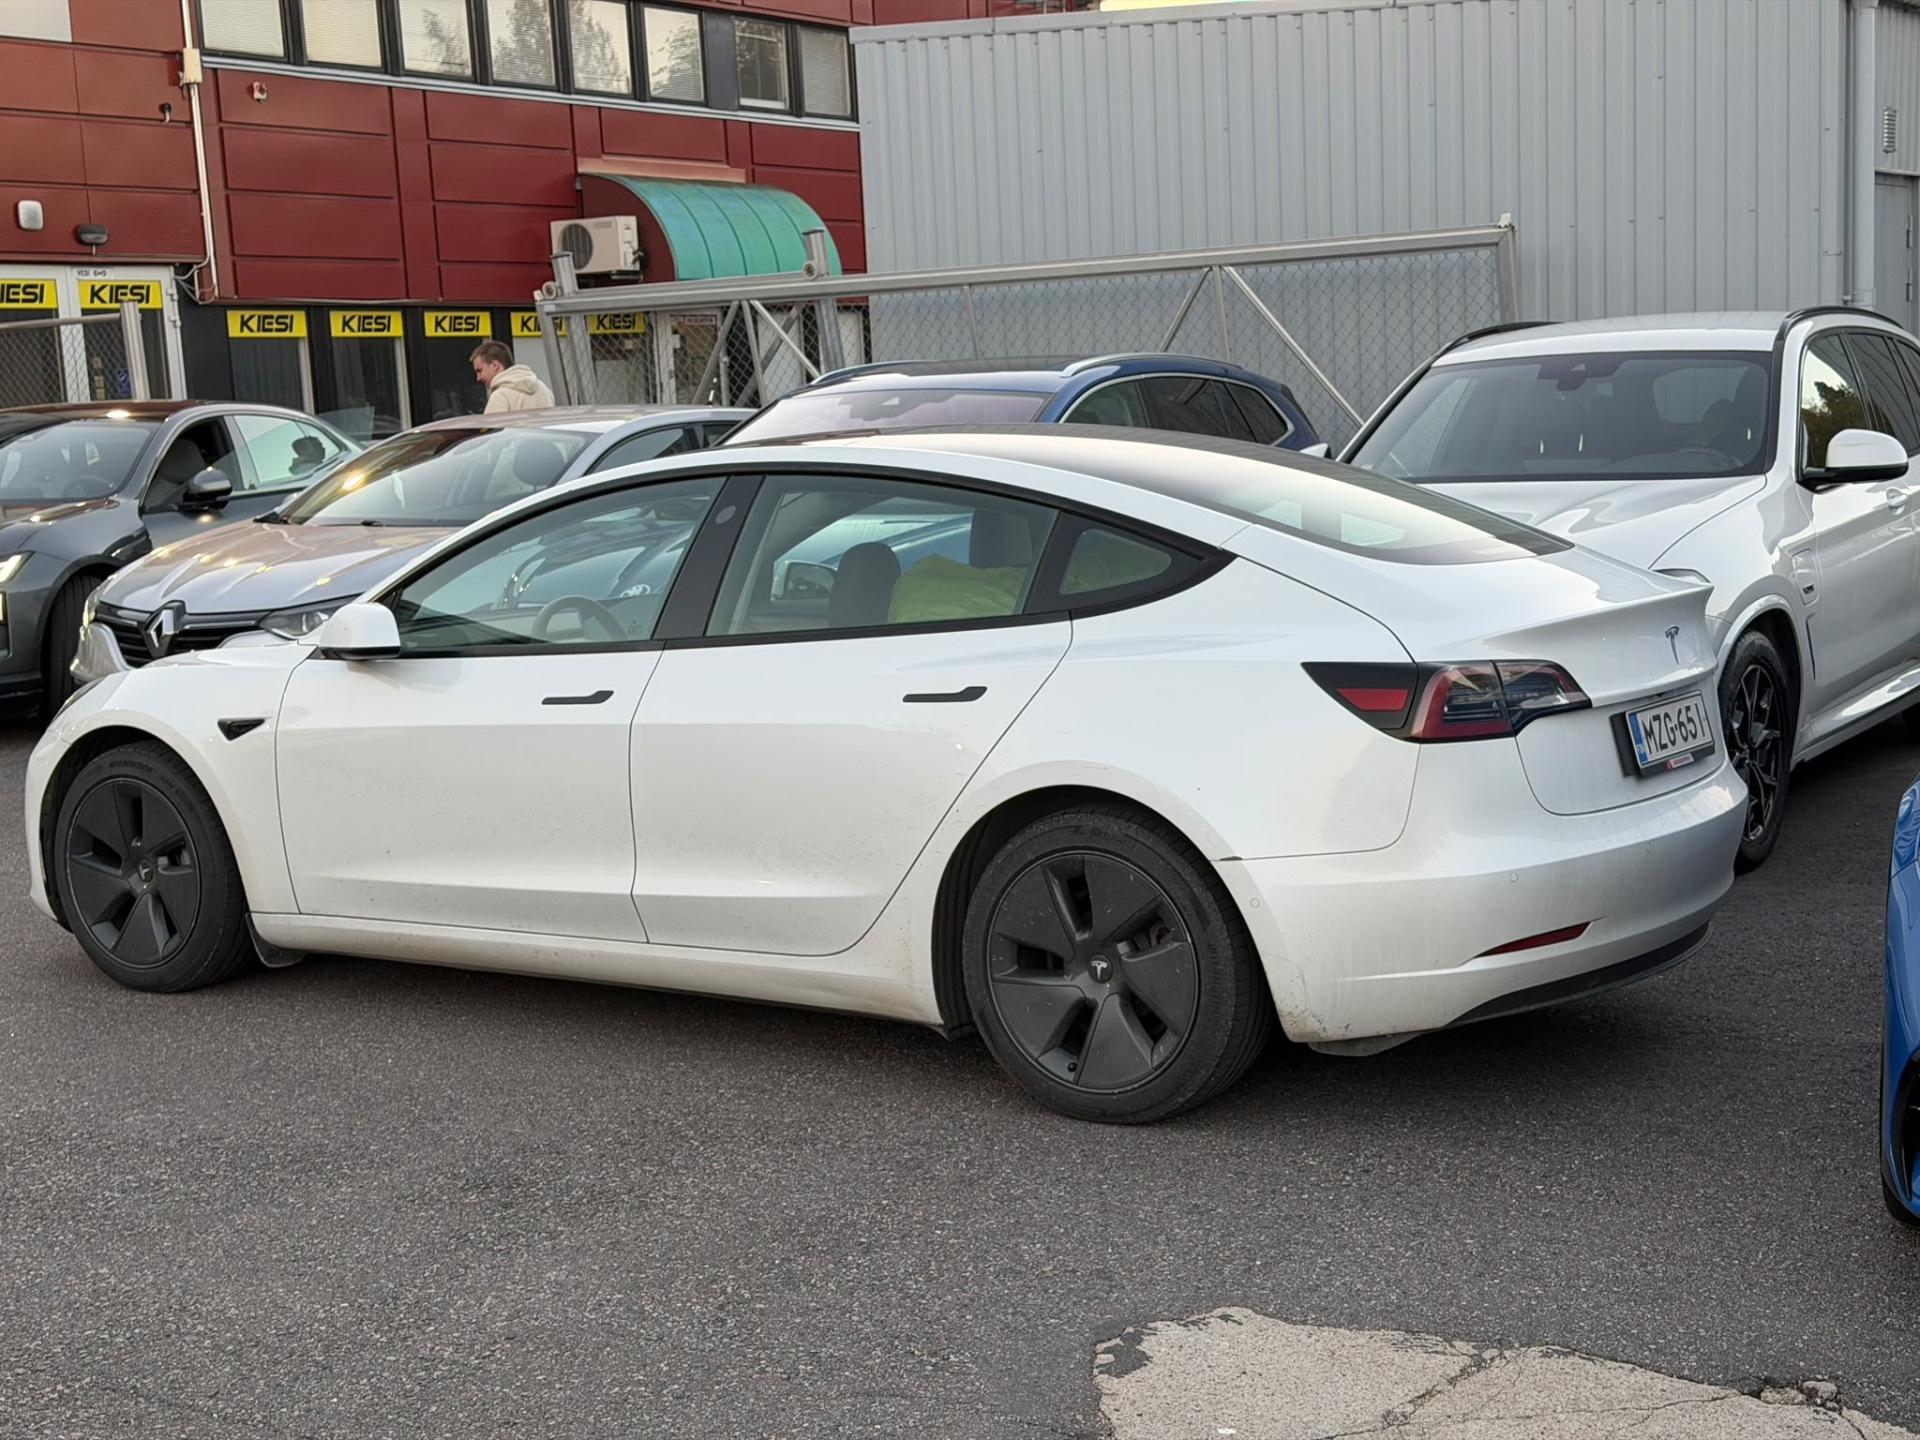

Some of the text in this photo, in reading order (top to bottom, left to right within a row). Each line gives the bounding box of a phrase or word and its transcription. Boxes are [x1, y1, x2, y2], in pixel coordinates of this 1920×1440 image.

[0, 283, 45, 304] IESI
[90, 284, 150, 304] KIESI
[240, 314, 294, 333] KIESI
[342, 314, 391, 333] KIESI
[434, 315, 480, 333] KIESI
[596, 313, 636, 330] KIESI
[1641, 703, 1705, 754] MZG-651
